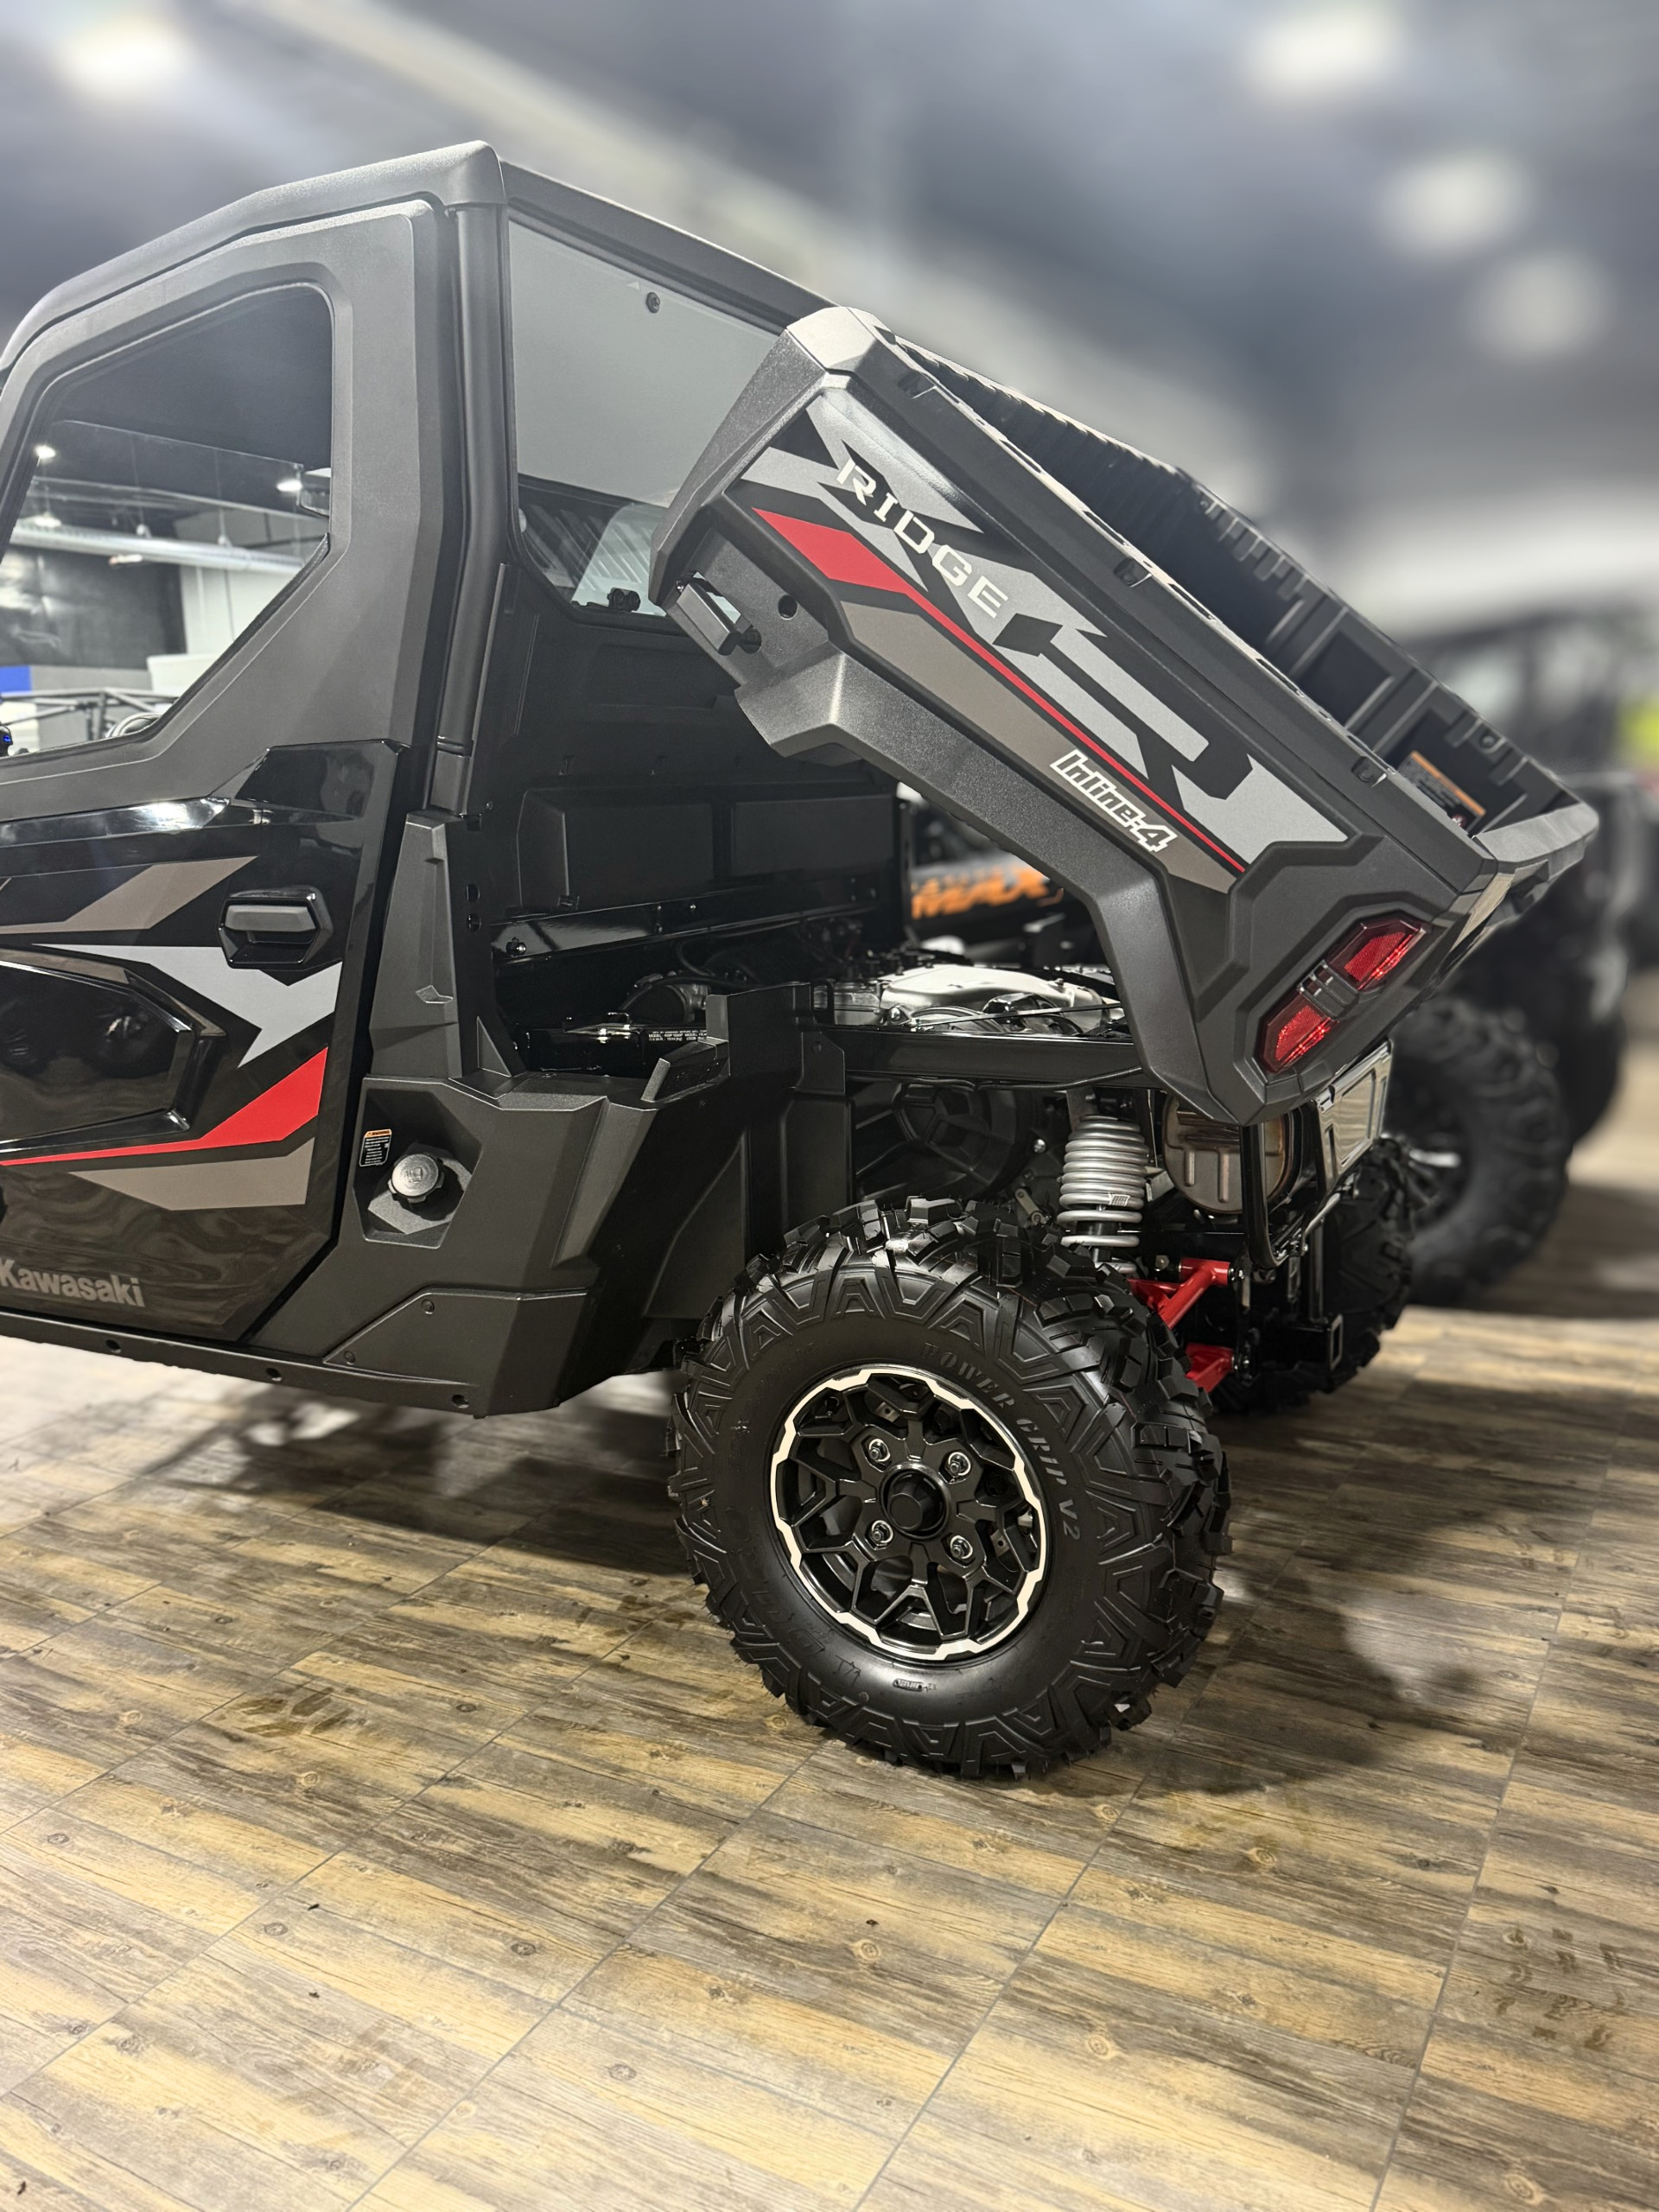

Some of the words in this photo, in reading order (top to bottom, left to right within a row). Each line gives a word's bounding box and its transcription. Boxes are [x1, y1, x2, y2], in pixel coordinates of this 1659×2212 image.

[836, 458, 1009, 619] RIDGE
[1049, 748, 1179, 853] Inline-4
[0, 1258, 145, 1308] Kawasaki
[918, 1342, 1016, 1408] POWER
[1015, 1417, 1068, 1486] GRIP
[1058, 1498, 1080, 1541] V2
